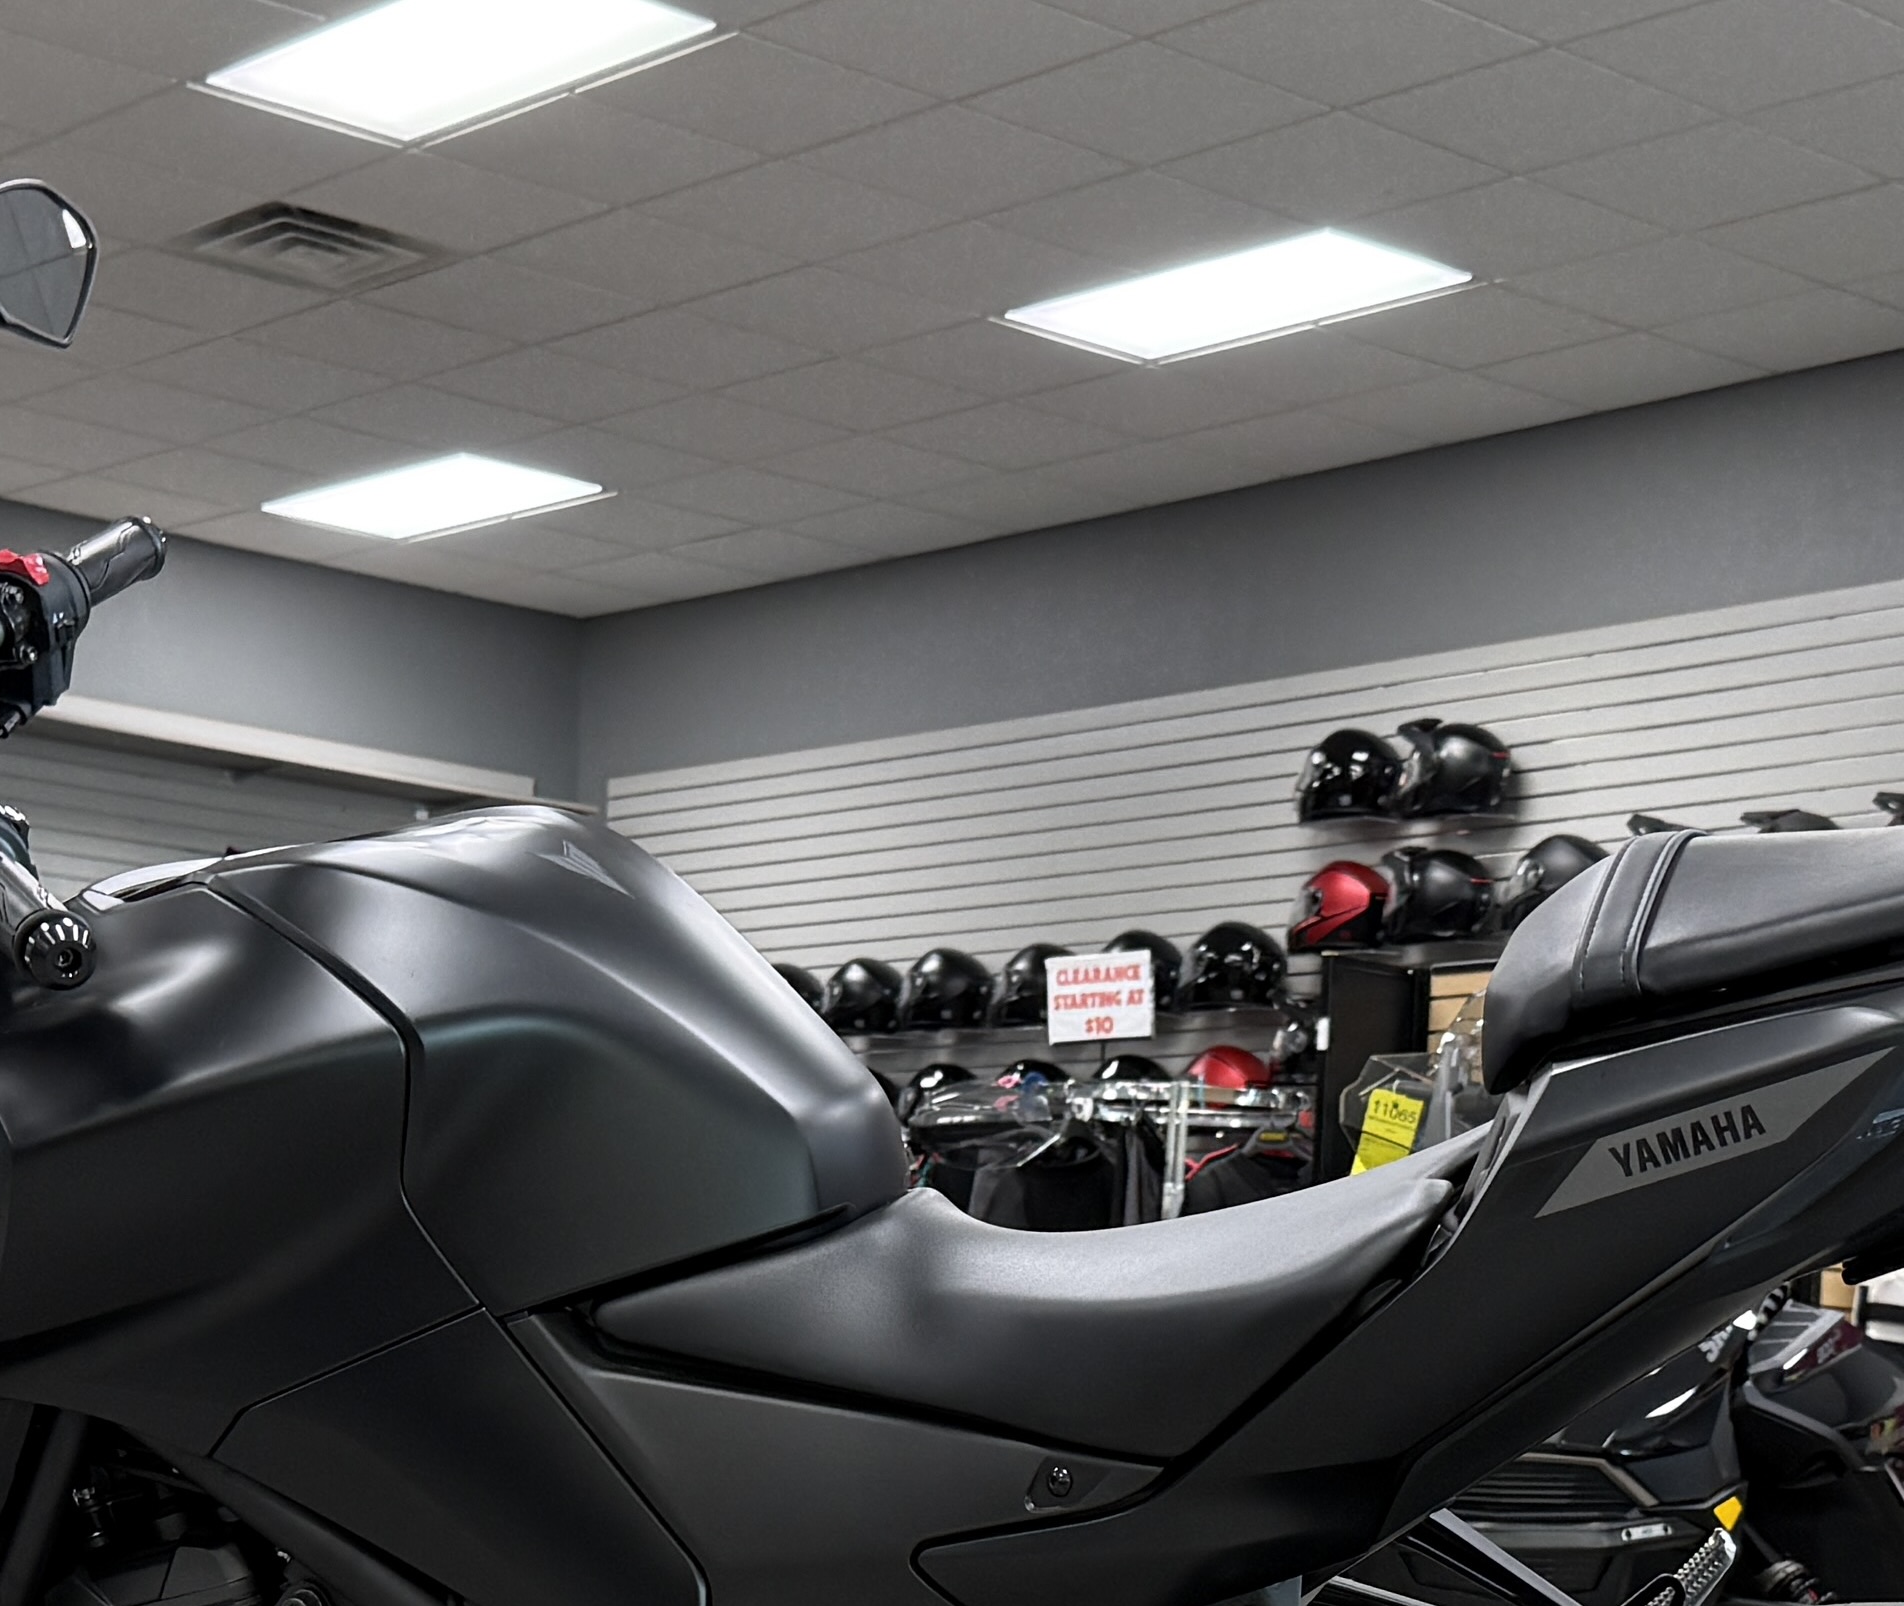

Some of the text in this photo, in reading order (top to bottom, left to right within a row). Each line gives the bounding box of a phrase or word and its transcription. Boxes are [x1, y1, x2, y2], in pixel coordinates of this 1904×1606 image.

[1056, 965, 1141, 987] CLEARANCE
[1054, 989, 1144, 1011] STARTING AT
[1084, 1016, 1114, 1034] $10
[1372, 1099, 1417, 1124] 11065
[1608, 1104, 1766, 1177] YAMAHA
